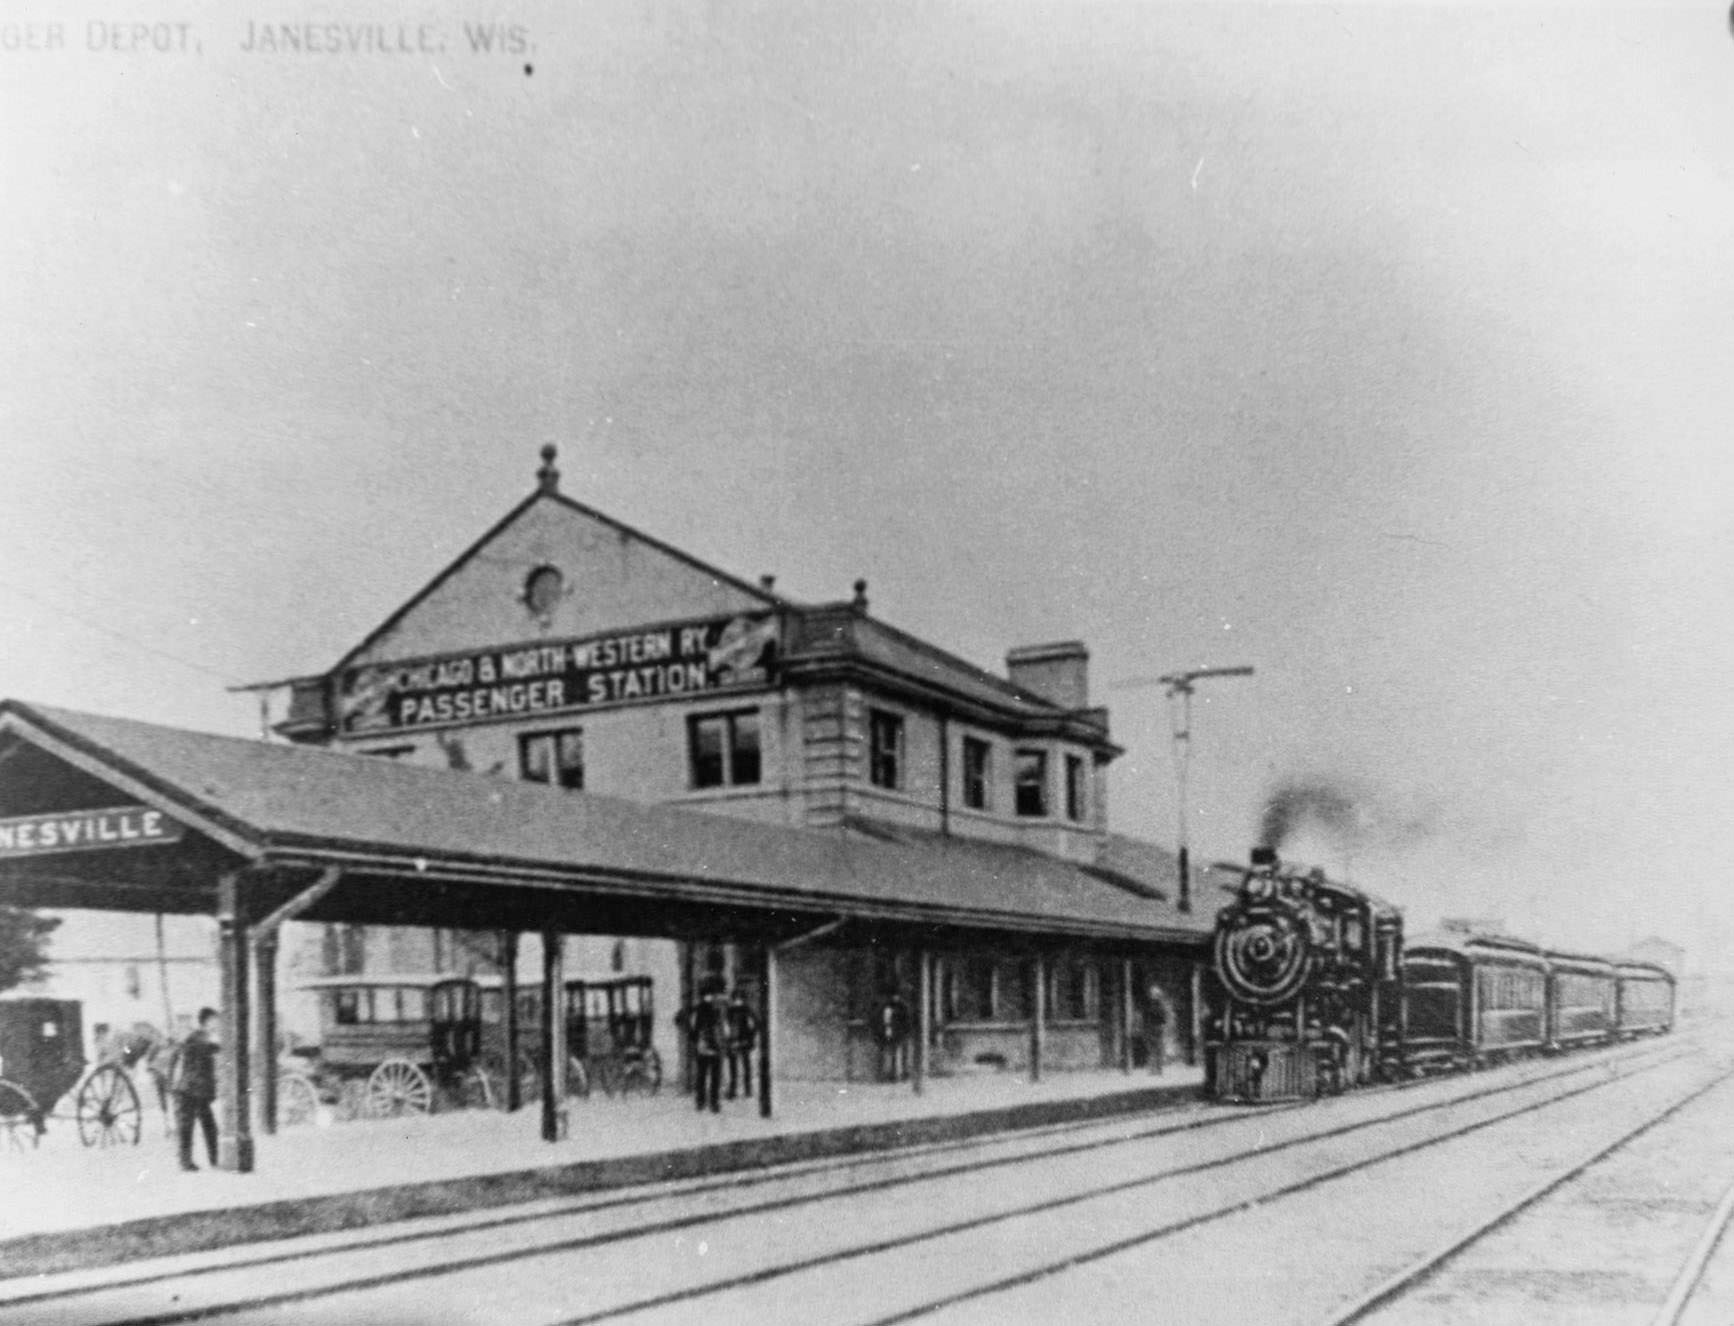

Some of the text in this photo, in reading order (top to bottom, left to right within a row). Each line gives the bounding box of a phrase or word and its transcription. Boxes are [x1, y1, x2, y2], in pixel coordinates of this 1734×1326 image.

[479, 656, 496, 682] &
[402, 662, 706, 724] PASSENGER STATION
